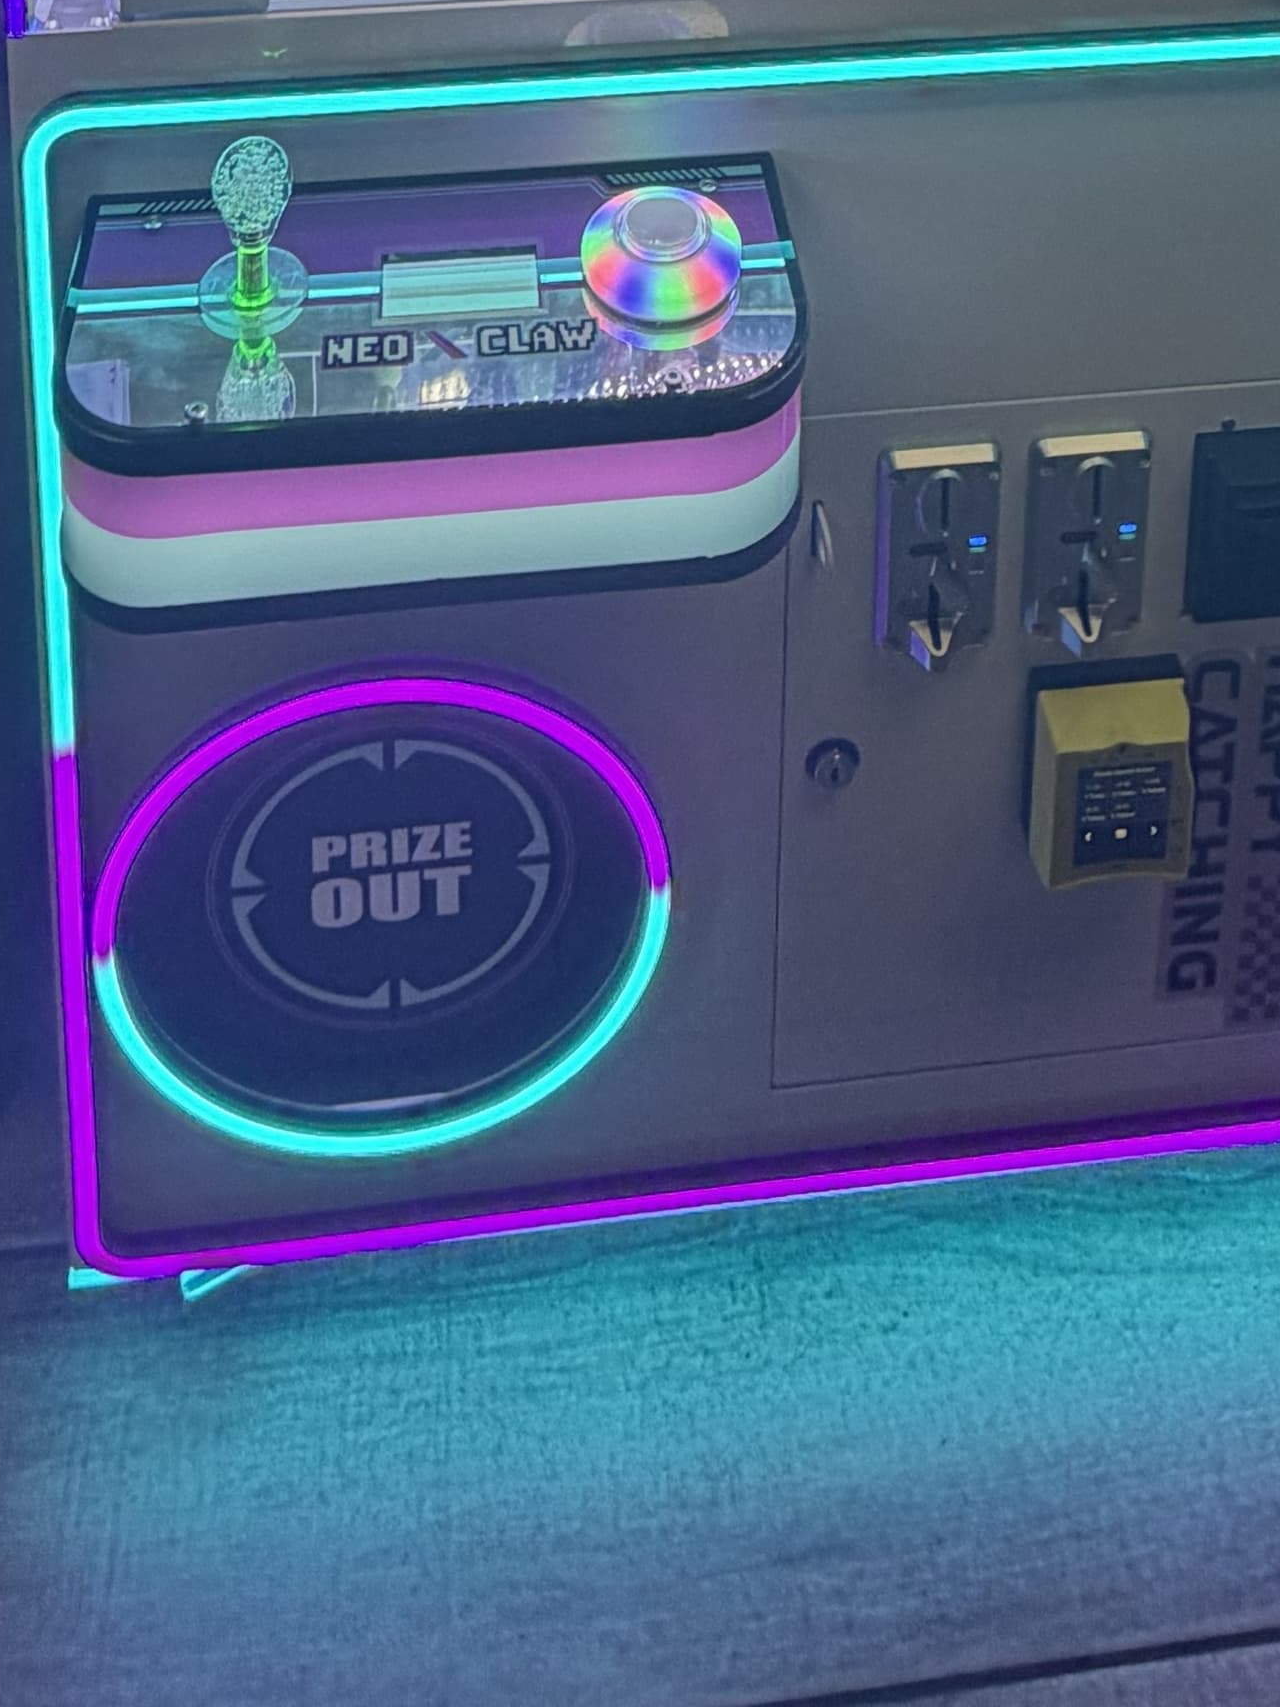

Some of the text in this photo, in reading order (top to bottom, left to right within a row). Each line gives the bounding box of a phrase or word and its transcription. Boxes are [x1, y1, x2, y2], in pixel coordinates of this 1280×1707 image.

[326, 319, 595, 365] NEO CLAW
[310, 820, 473, 873] PRIZE
[1166, 658, 1241, 992] CATCHING
[310, 864, 472, 929] OUT
